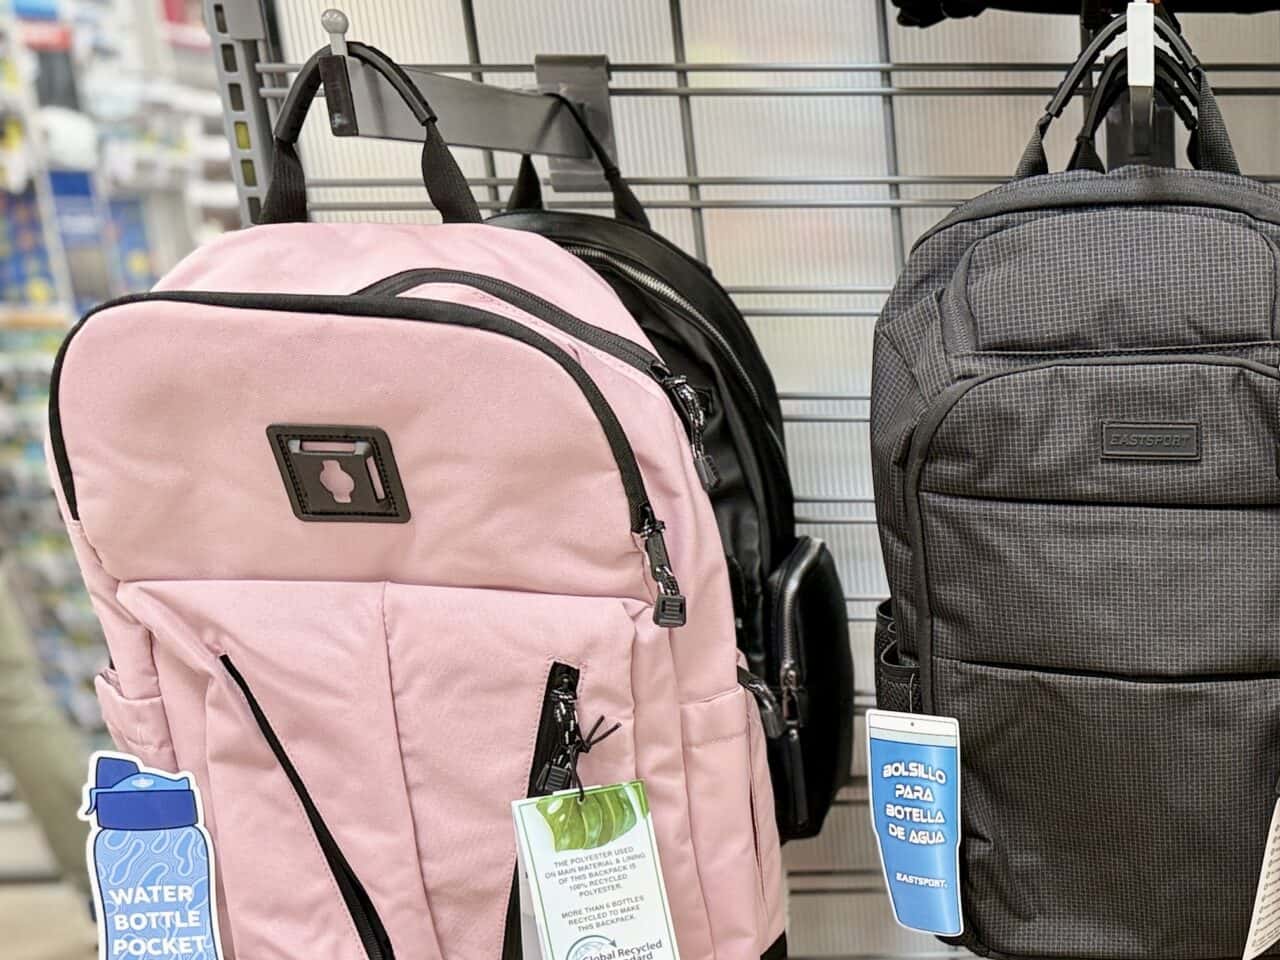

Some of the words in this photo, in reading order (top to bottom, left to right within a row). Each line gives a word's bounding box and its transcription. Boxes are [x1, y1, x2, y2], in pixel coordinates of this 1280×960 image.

[1110, 433, 1191, 447] EASTSPORT
[883, 761, 947, 785] BOLSILLO
[895, 784, 934, 802] PARA
[886, 804, 945, 823] BOTELLA
[888, 823, 906, 840] DE
[909, 830, 945, 844] AGUA
[544, 870, 556, 879] ON
[557, 866, 576, 876] MAIN
[578, 859, 613, 873] MATERIAL
[622, 852, 646, 863] LINING
[554, 859, 568, 869] THE
[570, 850, 612, 865] POLYESTER
[614, 846, 634, 856] USED
[558, 877, 568, 885] OF
[570, 873, 587, 883] THIS
[588, 865, 628, 878] BACKPACK
[630, 862, 637, 870] IS
[569, 881, 588, 892] 100%
[589, 873, 628, 886] RECYCLED
[108, 885, 193, 905] WATER
[561, 909, 583, 919] MORE
[584, 904, 605, 913] THAN
[612, 895, 644, 908] BOTTLES
[568, 911, 608, 926] RECYCLED
[609, 908, 618, 917] TO
[620, 904, 640, 914] MAKE
[113, 910, 200, 931] BOTTLE
[578, 923, 594, 932] THIS
[113, 935, 207, 956] POCKET
[617, 938, 663, 958] Recycled
